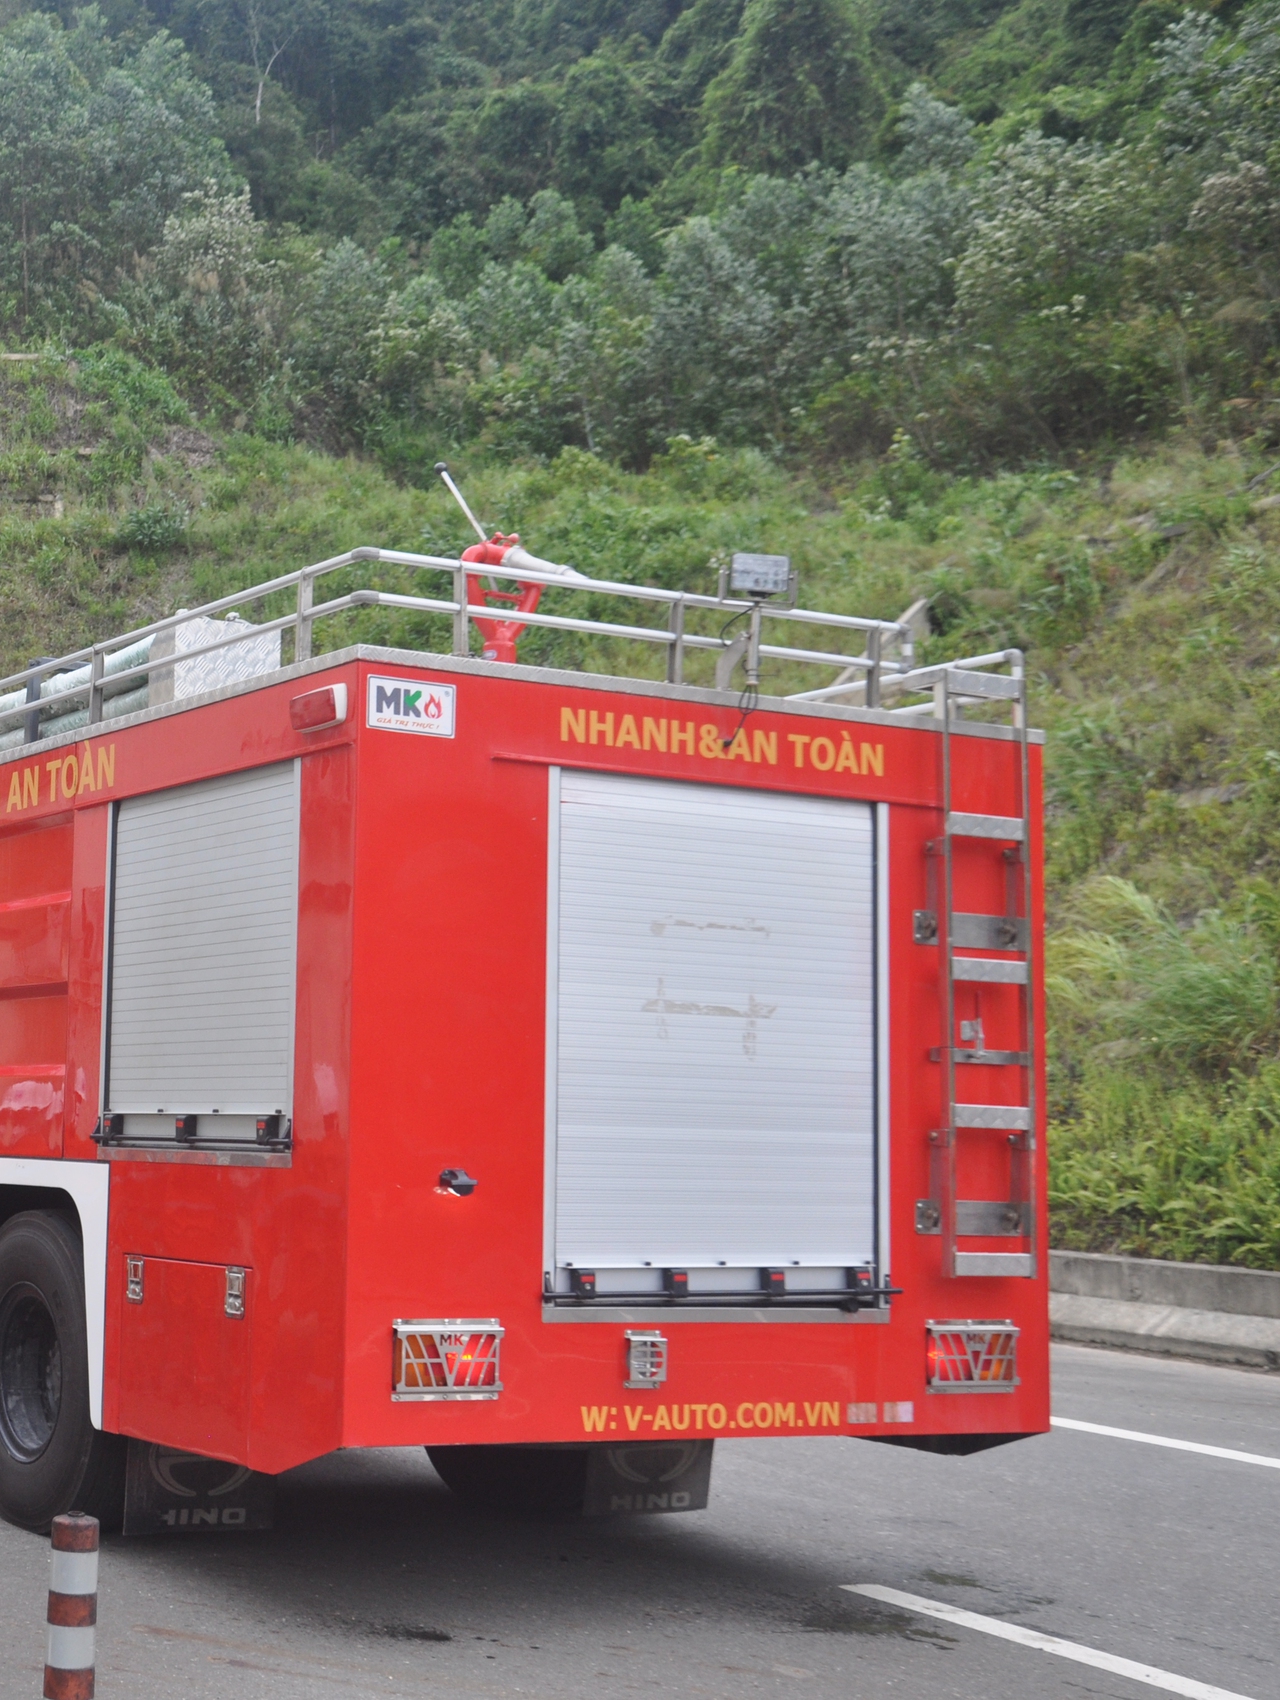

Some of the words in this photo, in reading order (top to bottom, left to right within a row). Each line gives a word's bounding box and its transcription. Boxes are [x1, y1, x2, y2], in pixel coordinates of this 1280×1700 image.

[376, 685, 422, 718] MK
[787, 730, 884, 777] TOÀN
[6, 765, 39, 814] AN
[46, 740, 115, 803] TOÀN
[440, 1333, 464, 1346] MK
[580, 1405, 617, 1432] W:
[624, 1401, 841, 1432] V-AUTO.COM.VN
[610, 1490, 691, 1511] HINO
